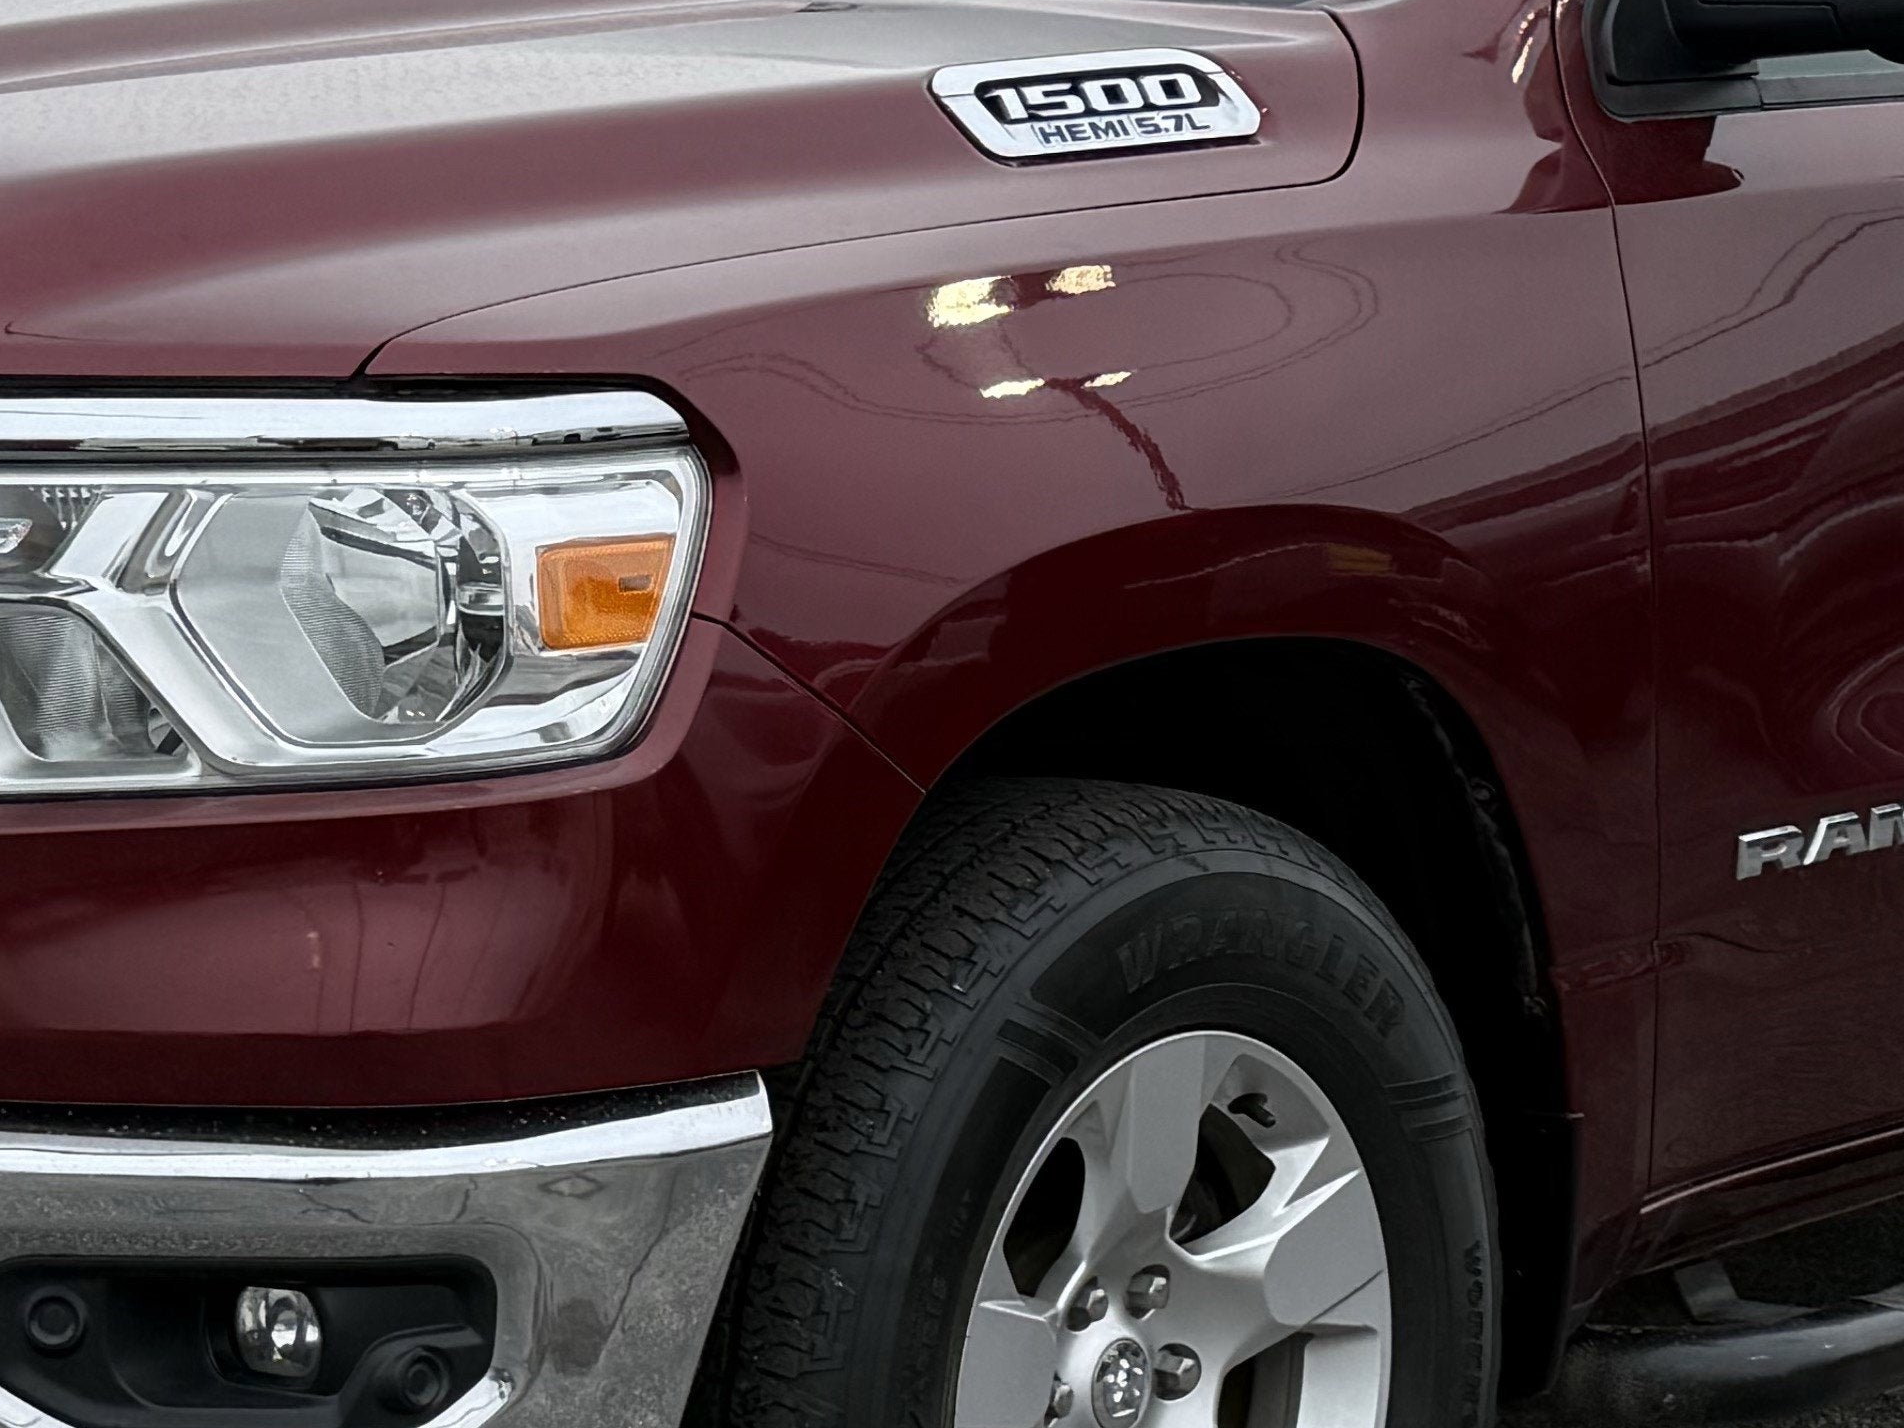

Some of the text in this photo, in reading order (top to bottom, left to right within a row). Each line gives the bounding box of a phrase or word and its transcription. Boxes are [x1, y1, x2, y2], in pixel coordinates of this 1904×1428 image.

[984, 72, 1203, 120] 1500
[1037, 112, 1211, 146] HEMI 5.7L
[1114, 907, 1406, 1040] WRANGLER
